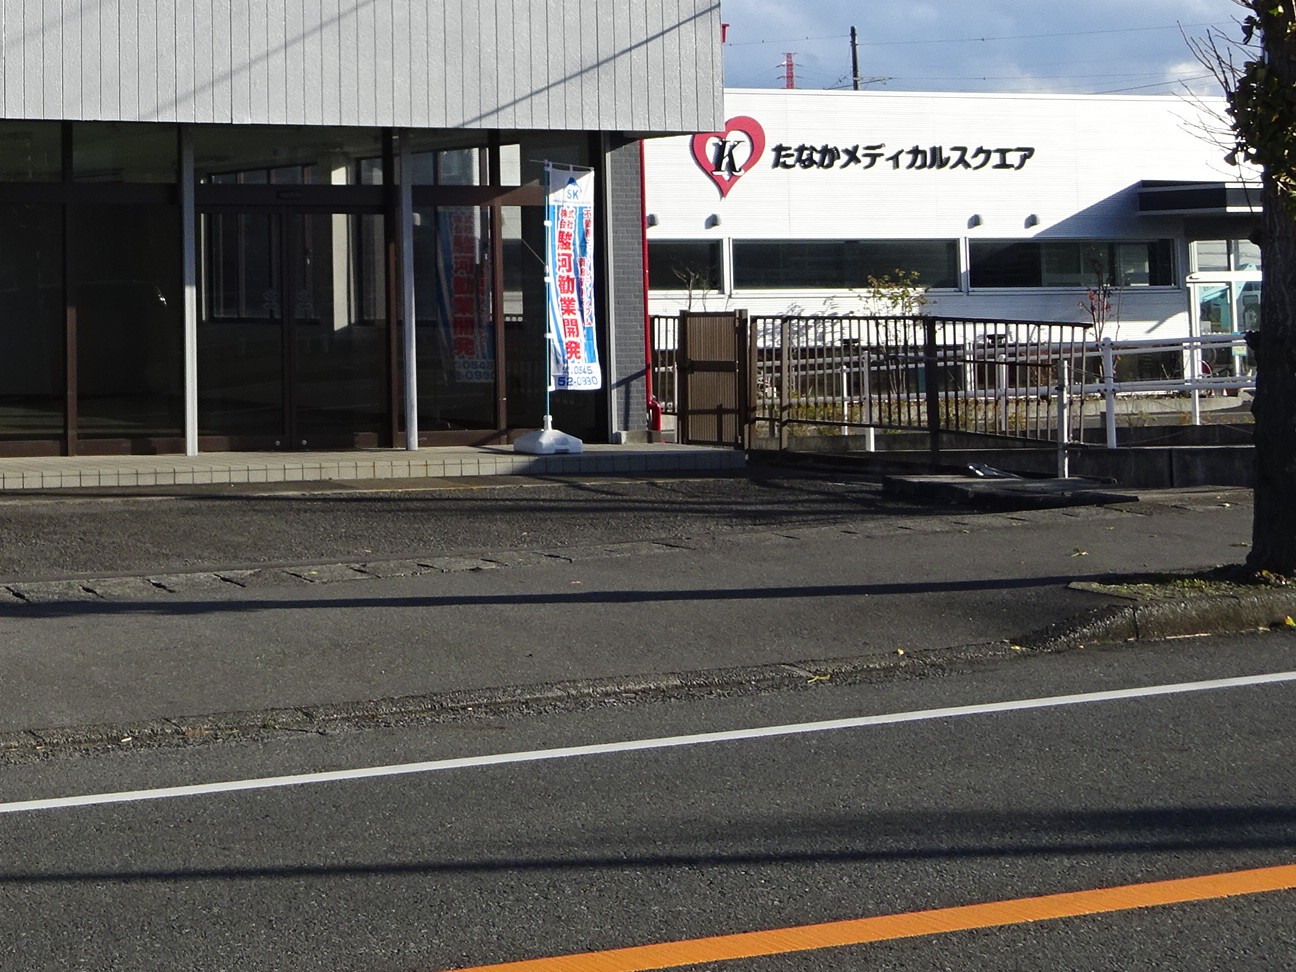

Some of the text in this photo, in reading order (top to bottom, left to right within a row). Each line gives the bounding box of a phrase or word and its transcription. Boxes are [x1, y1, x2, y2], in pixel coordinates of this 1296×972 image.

[771, 143, 1035, 171] たなかメディカルスクエア
[566, 189, 579, 200] SK
[557, 230, 582, 360] 駿河勧業開発
